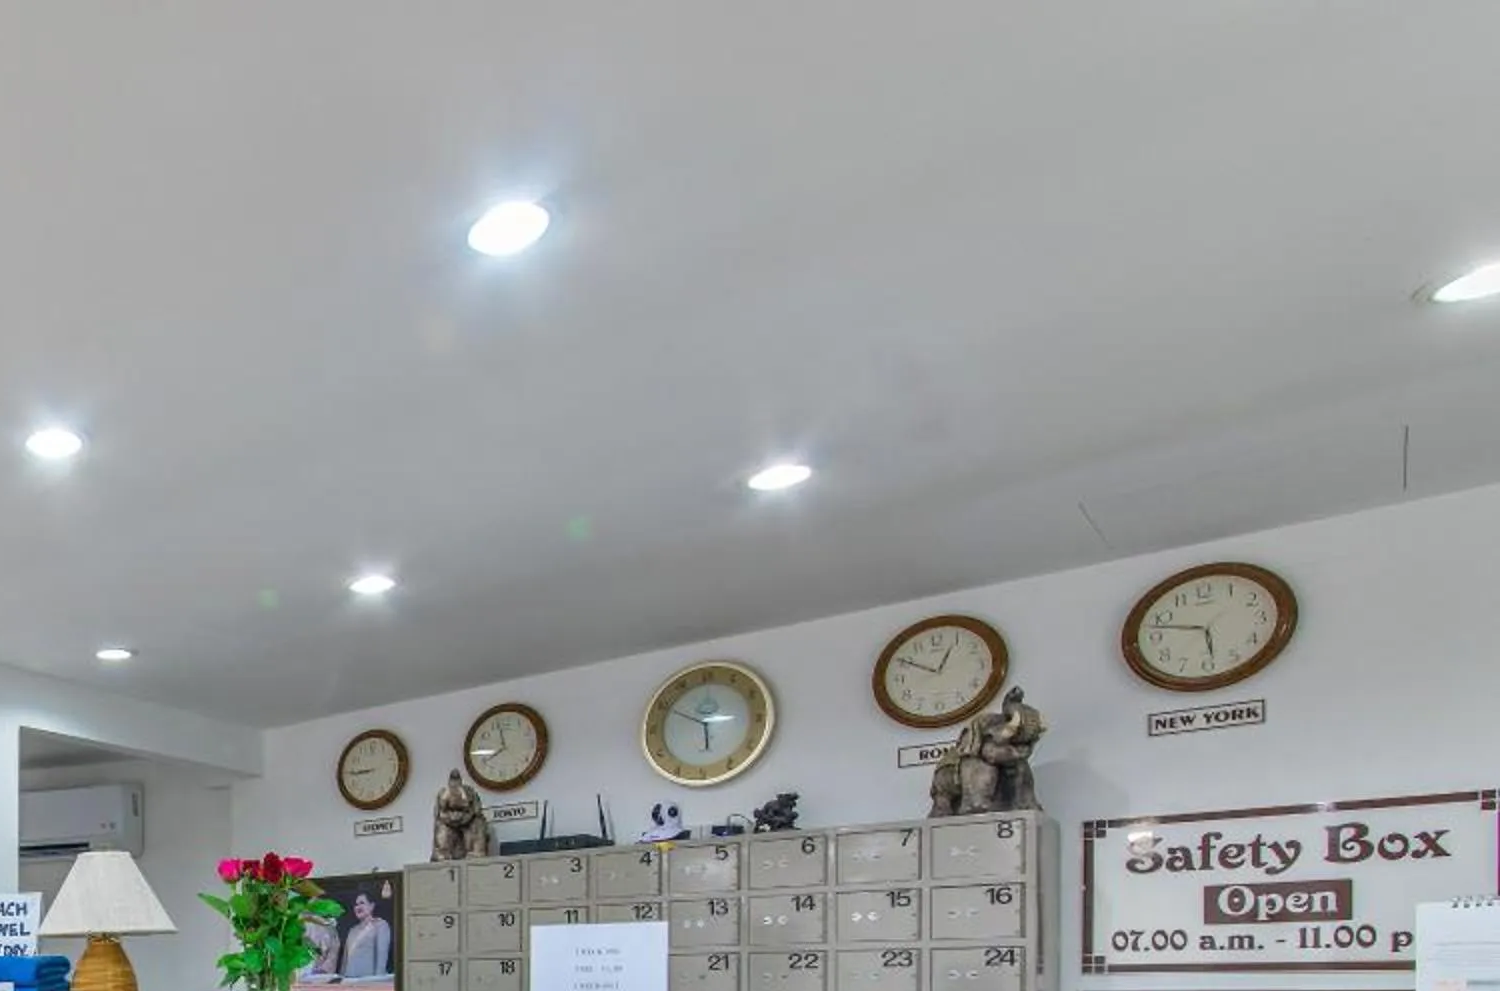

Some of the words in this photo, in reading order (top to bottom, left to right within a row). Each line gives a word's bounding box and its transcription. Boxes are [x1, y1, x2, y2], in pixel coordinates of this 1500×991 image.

[1155, 714, 1196, 730] NEW
[1203, 707, 1260, 724] YORK
[998, 822, 1013, 838] 8
[901, 829, 912, 846] 7
[802, 838, 815, 853] 6
[1125, 831, 1303, 875] Safety
[1323, 822, 1452, 863] Box
[640, 852, 651, 865] 4
[716, 846, 728, 860] 5
[504, 866, 514, 878] 2
[571, 859, 581, 872] 3
[450, 870, 455, 882] 1
[887, 891, 910, 907] 15
[986, 888, 1012, 904] 16
[1217, 885, 1339, 921] Open
[709, 901, 728, 915] 13
[792, 896, 815, 911] 14
[565, 910, 579, 923] 11
[633, 905, 653, 919] 12
[444, 916, 454, 929] 9
[500, 913, 514, 926] 10
[1111, 929, 1188, 952] 07.00
[1199, 935, 1265, 951] a.m.
[1297, 924, 1378, 949] 11.00
[709, 956, 729, 970] 21
[789, 954, 818, 969] 22
[882, 951, 912, 967] 23
[985, 949, 1015, 966] 24
[439, 963, 452, 976] 17
[500, 961, 514, 974] 18
